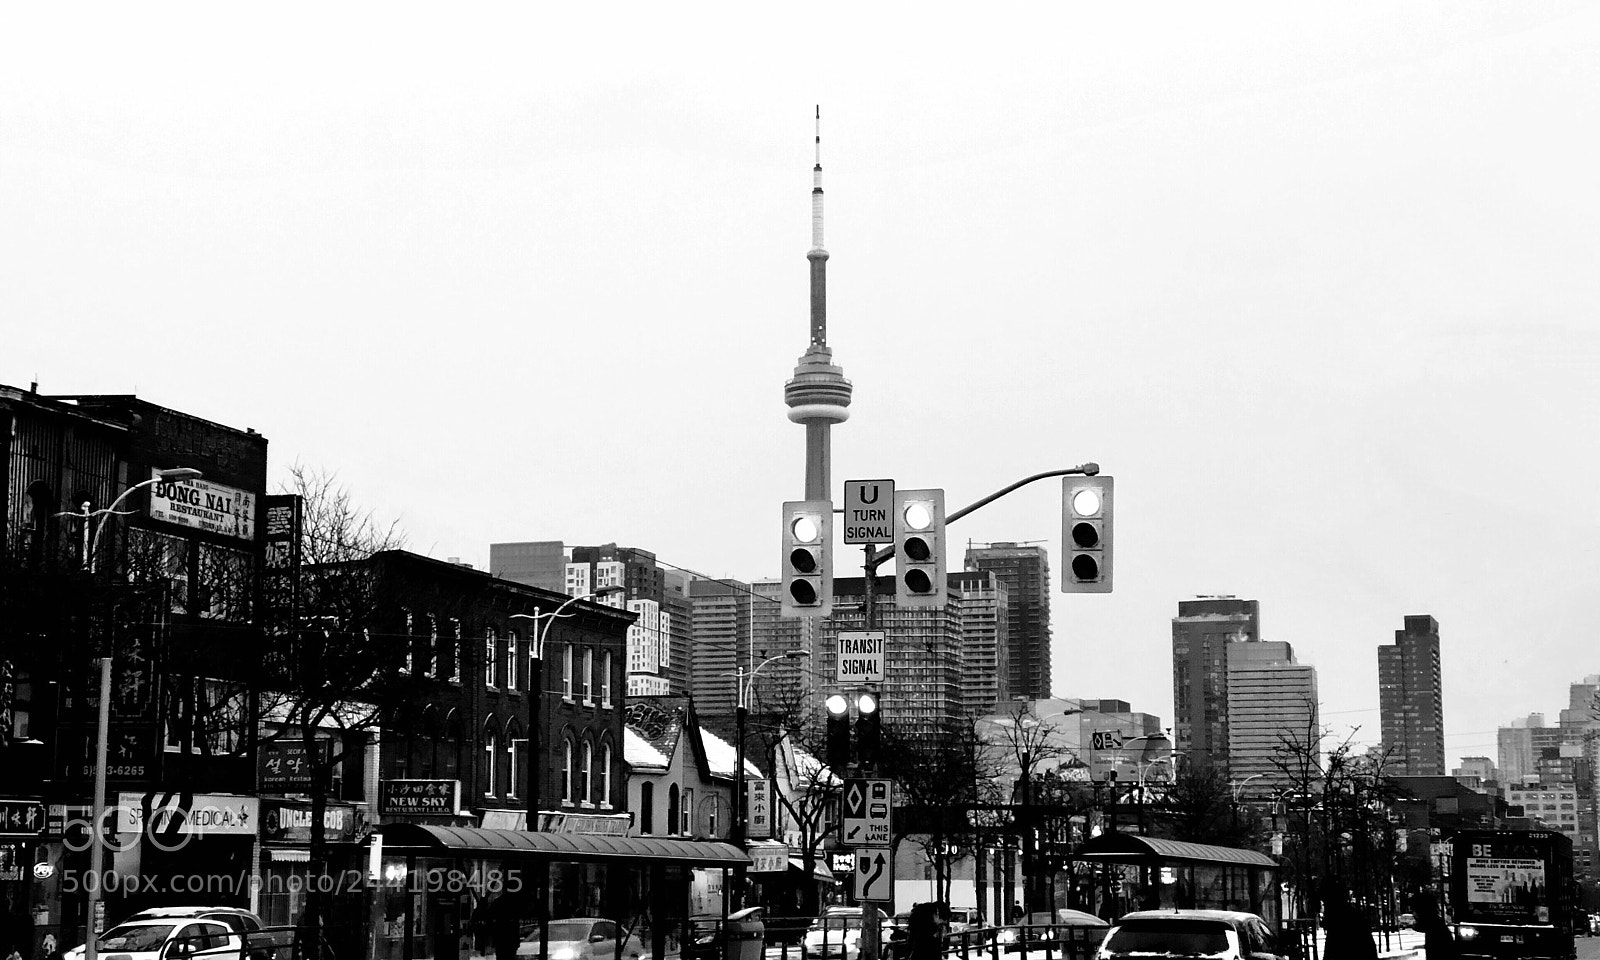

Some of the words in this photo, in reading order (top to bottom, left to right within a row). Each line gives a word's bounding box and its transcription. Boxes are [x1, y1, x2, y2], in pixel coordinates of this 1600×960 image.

[860, 485, 879, 505] U
[205, 492, 232, 515] NAI
[170, 502, 224, 523] RESTAURANT
[853, 509, 886, 521] TURN
[847, 526, 892, 538] SIGNAL
[839, 638, 883, 654] TRANSIT
[842, 659, 879, 675] SIGNAL
[389, 797, 419, 807] NEW
[421, 797, 448, 807] SKY
[184, 809, 236, 827] MEDICAL
[279, 807, 313, 829] UNCLE
[869, 824, 889, 832] THIS
[865, 833, 889, 841] LANE
[1471, 843, 1493, 858] BE
